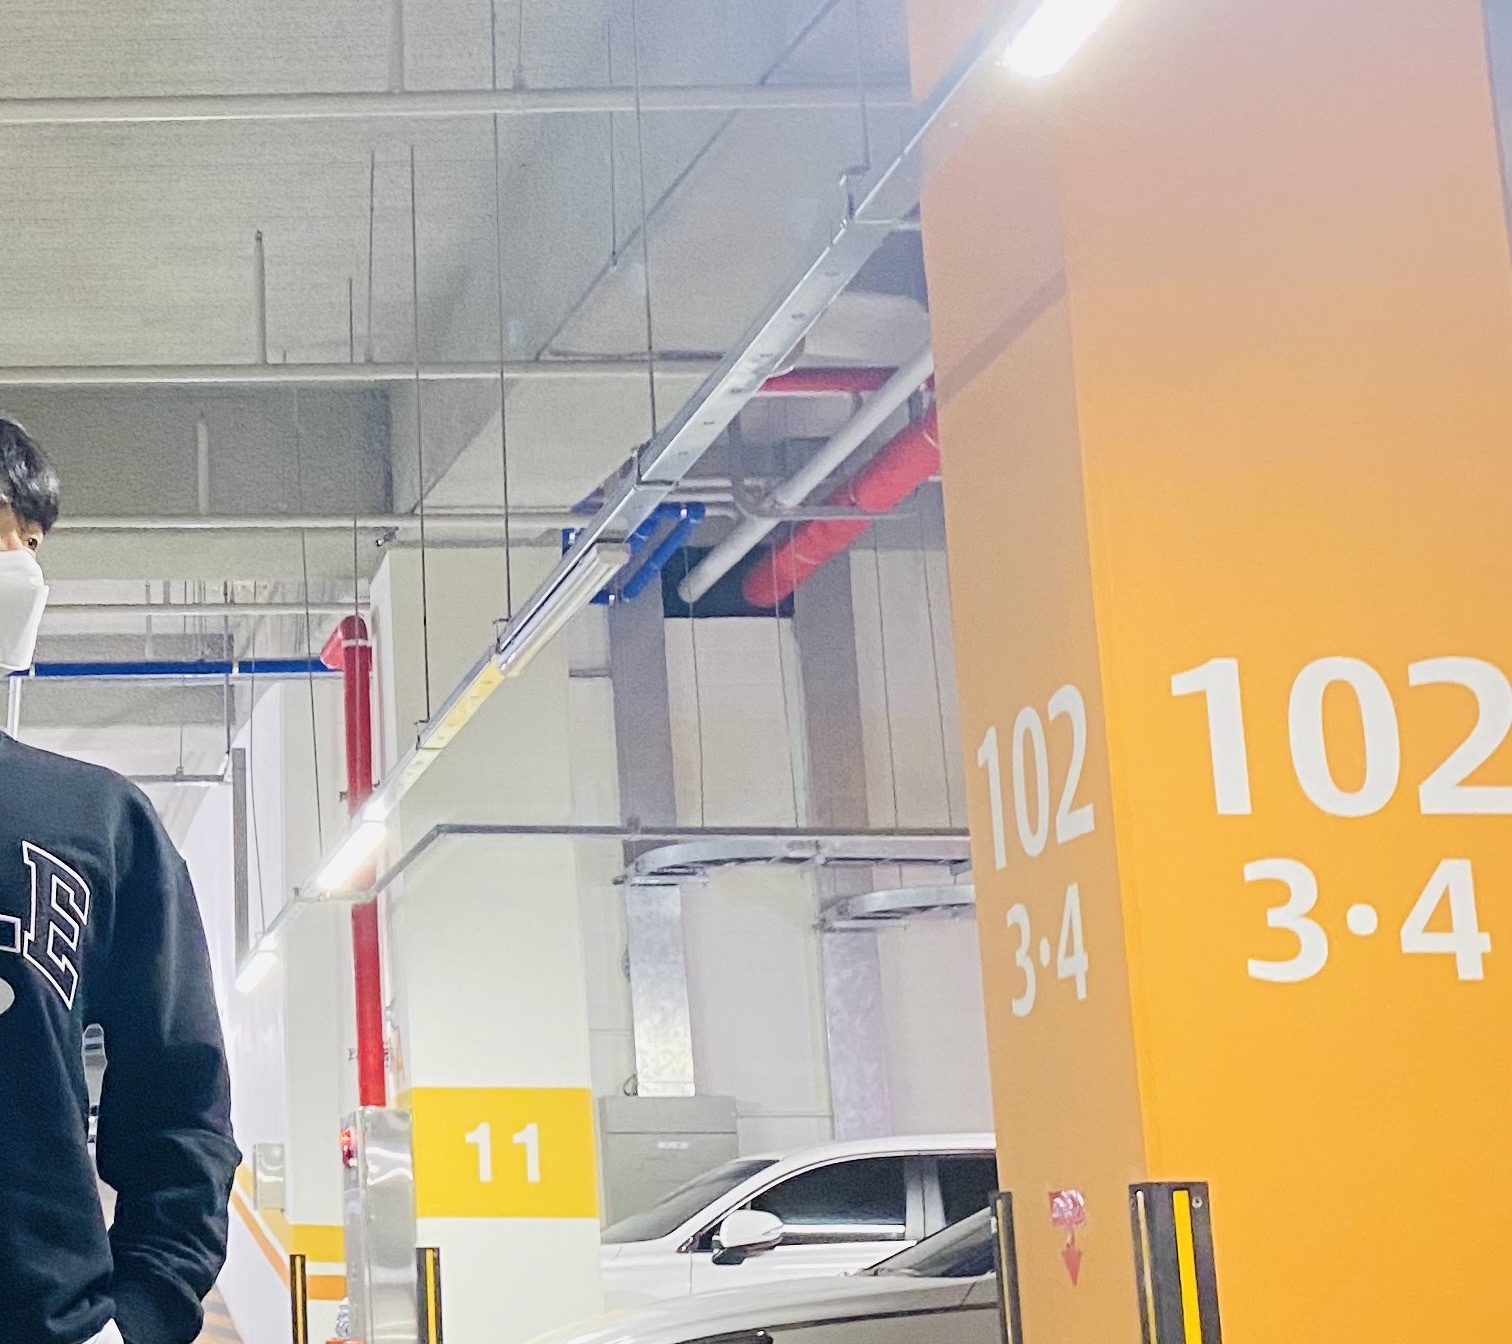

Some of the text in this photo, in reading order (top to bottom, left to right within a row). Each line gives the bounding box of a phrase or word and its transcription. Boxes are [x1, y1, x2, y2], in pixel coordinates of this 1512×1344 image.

[977, 683, 1095, 870] 102
[1171, 656, 1512, 818] 102
[464, 1121, 541, 1184] 11
